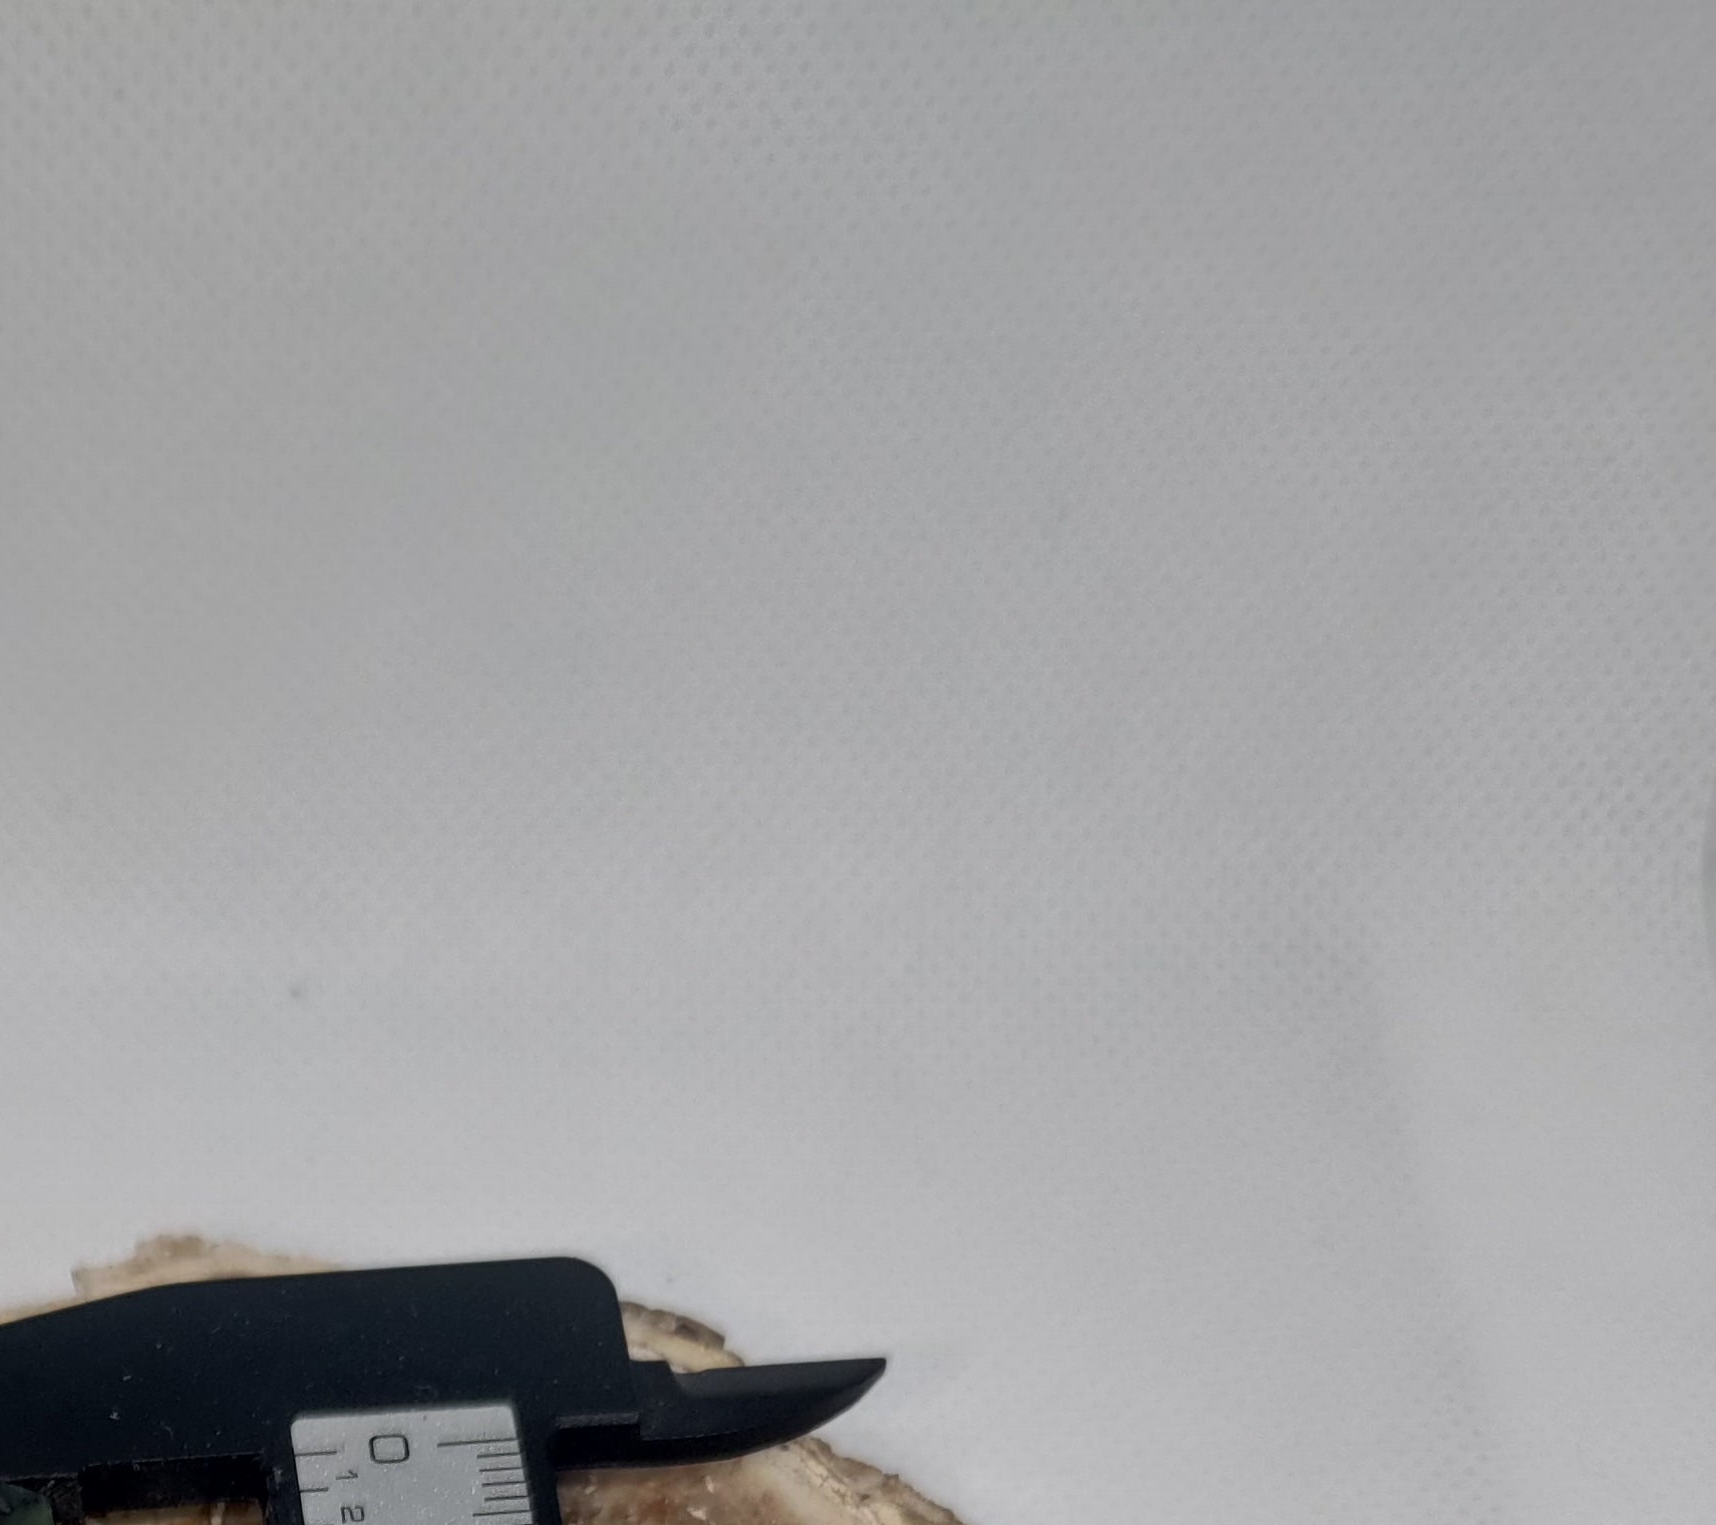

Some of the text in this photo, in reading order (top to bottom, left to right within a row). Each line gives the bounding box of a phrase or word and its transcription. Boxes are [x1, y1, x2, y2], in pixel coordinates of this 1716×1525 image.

[369, 1434, 410, 1464] 0
[335, 1469, 359, 1480] 1
[341, 1505, 365, 1524] 2
